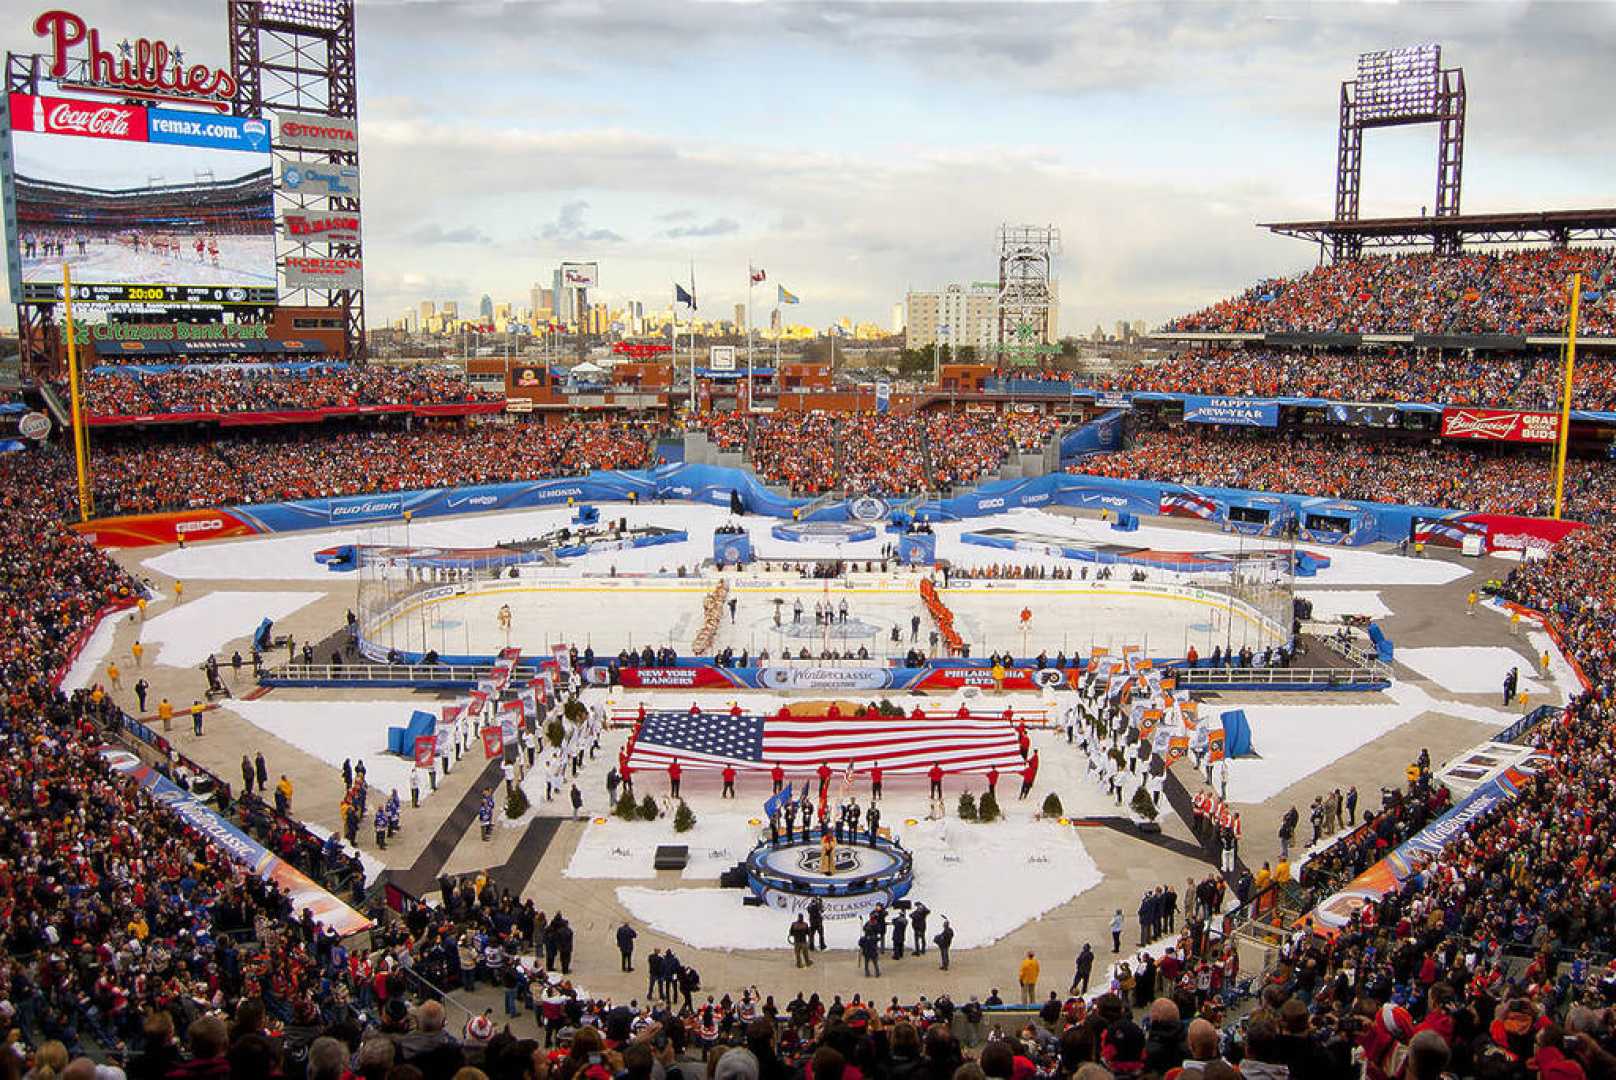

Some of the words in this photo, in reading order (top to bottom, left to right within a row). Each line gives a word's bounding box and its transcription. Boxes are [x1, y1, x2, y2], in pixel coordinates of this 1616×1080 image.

[33, 10, 238, 98] Phillies
[50, 103, 133, 135] Coca-Cola
[301, 124, 355, 141] TOYOTA
[286, 256, 362, 270] HORIZON
[81, 286, 91, 299] 0
[128, 288, 164, 299] 20:00
[214, 289, 223, 301] 0
[95, 324, 174, 341] Citizens
[178, 323, 226, 340] Bank
[228, 321, 268, 339] Park
[1210, 399, 1253, 407] HAPPY
[1199, 407, 1224, 417] NEW
[1228, 408, 1264, 418] YEAR
[1446, 414, 1516, 431] Budweiser
[1522, 415, 1559, 425] GRAB
[1521, 429, 1557, 440] BUDS
[978, 498, 1005, 510] GEICO
[1101, 497, 1128, 506] verizon
[334, 506, 360, 516] BUD
[361, 503, 400, 513] LIGHT
[175, 519, 224, 533] GEICO
[637, 670, 665, 678] NEW
[666, 670, 697, 678] YORK
[641, 677, 694, 686] RANGERS
